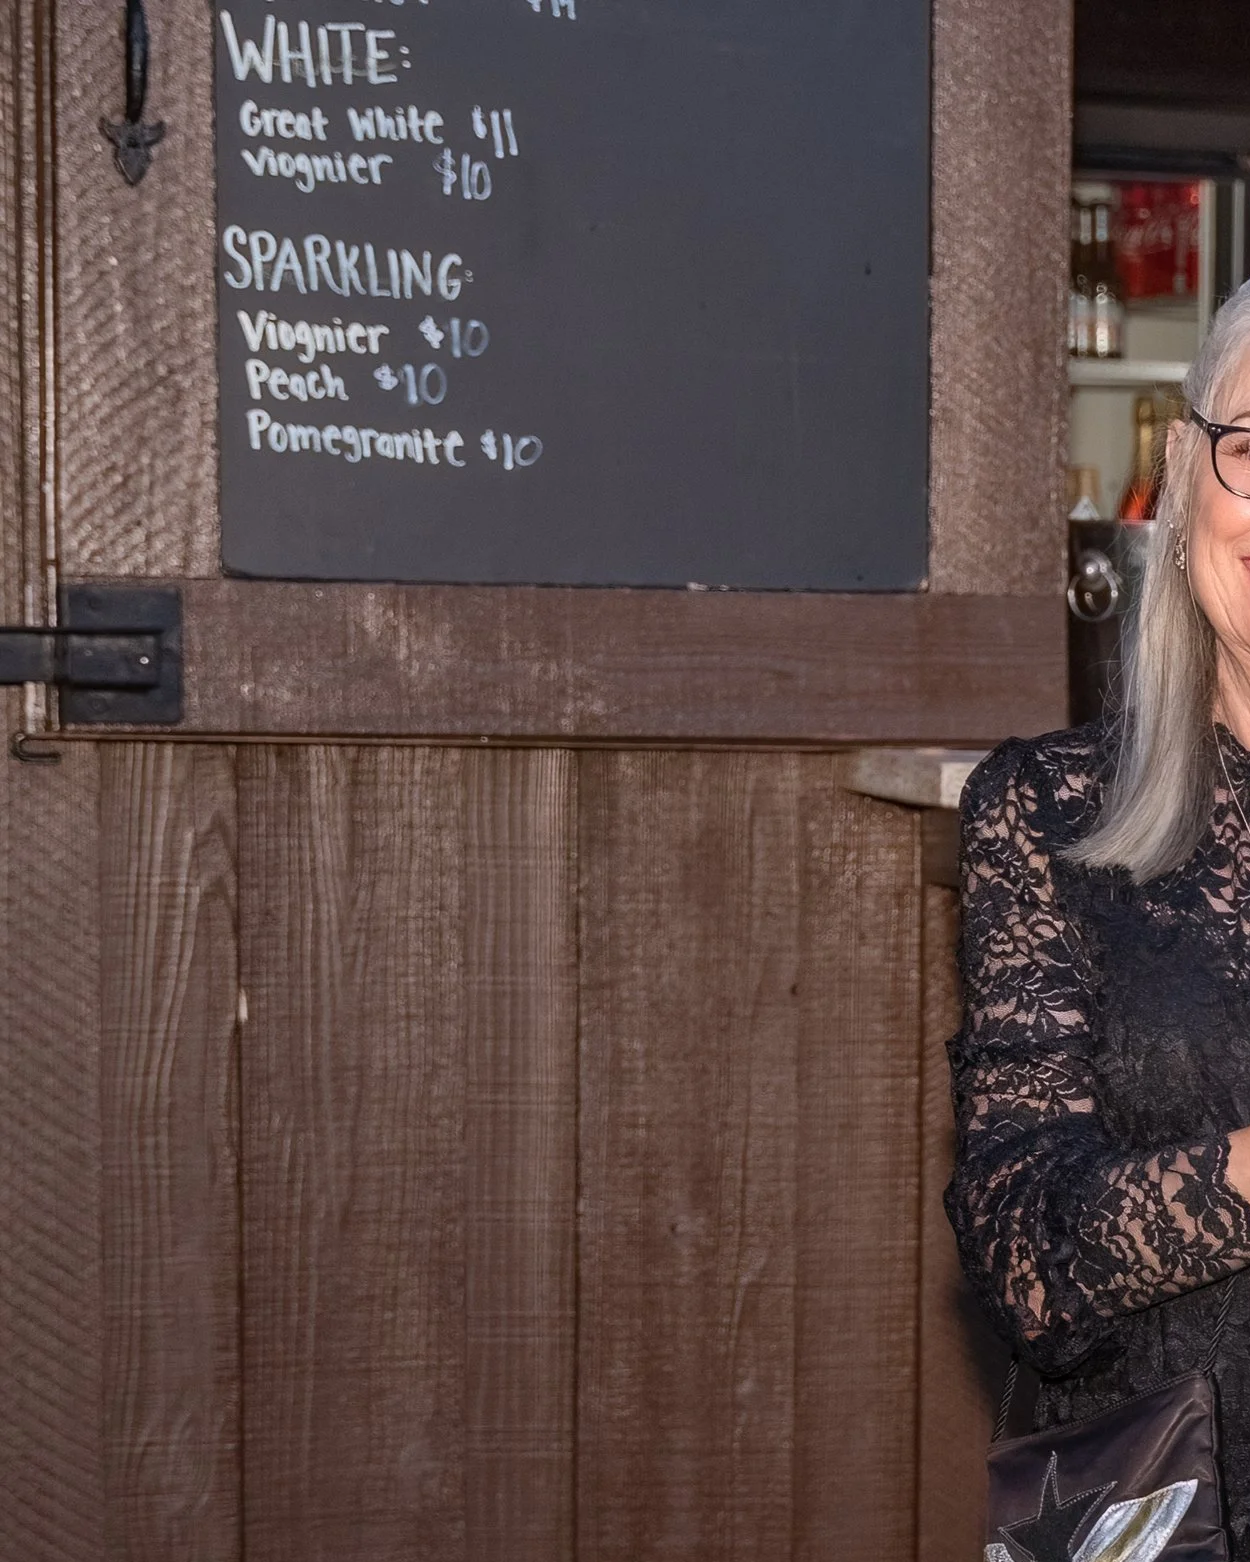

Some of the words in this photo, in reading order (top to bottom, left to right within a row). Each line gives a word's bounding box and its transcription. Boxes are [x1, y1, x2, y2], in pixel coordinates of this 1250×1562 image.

[220, 9, 411, 88] WHITE:
[239, 98, 329, 141] Great
[471, 104, 519, 159] $11
[432, 147, 492, 200] $10
[236, 309, 390, 363] Viognier
[418, 314, 490, 358] $10
[245, 358, 349, 402] Peach
[373, 362, 448, 406] $10
[245, 408, 467, 468] Pomegranite
[480, 429, 543, 471] $10
